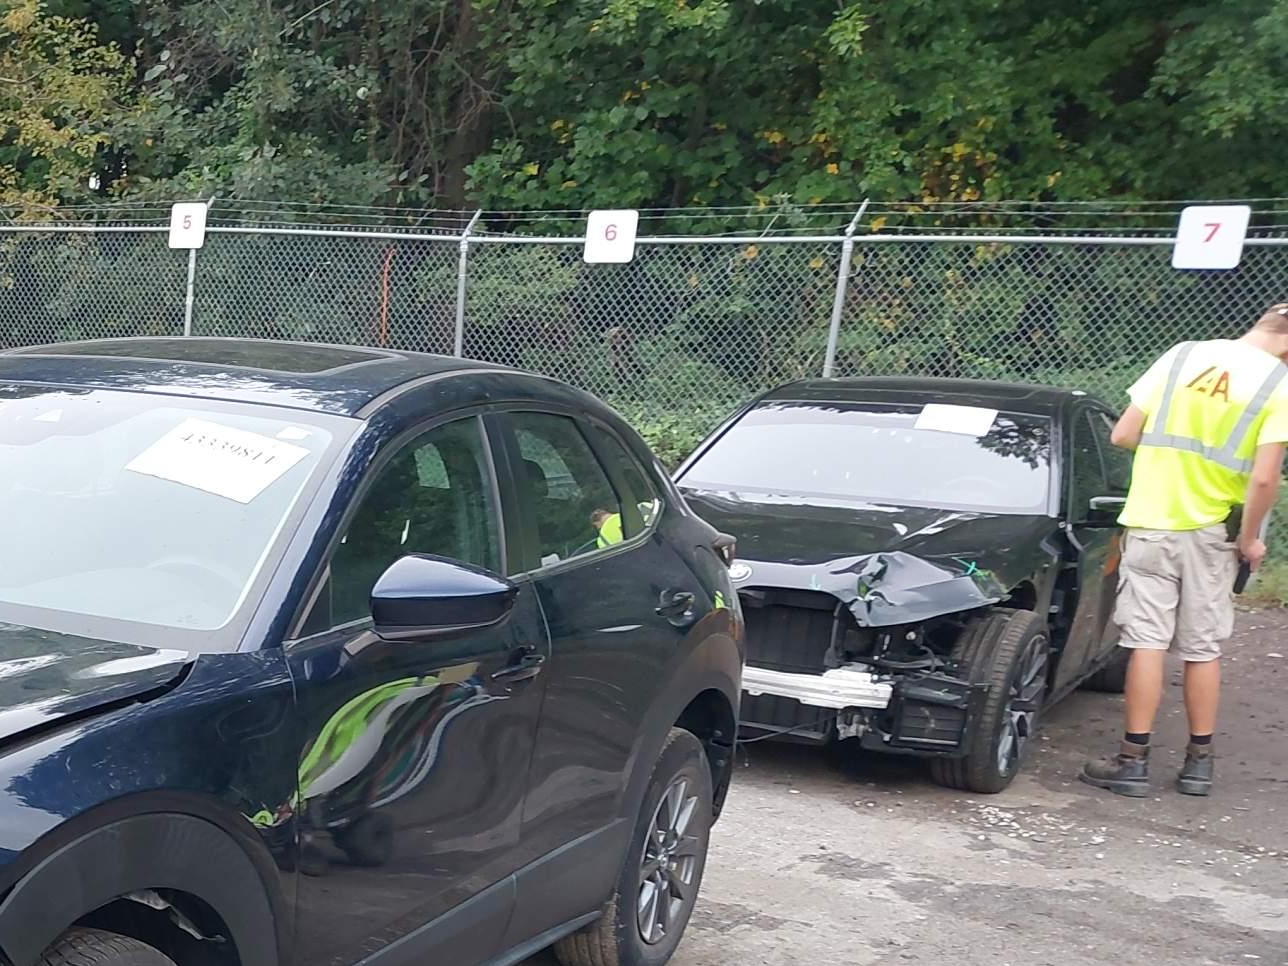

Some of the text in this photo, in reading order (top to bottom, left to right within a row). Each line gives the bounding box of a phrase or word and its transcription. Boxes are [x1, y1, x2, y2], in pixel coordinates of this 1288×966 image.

[183, 215, 192, 230] 5
[605, 224, 617, 241] 6
[1203, 223, 1222, 243] 7
